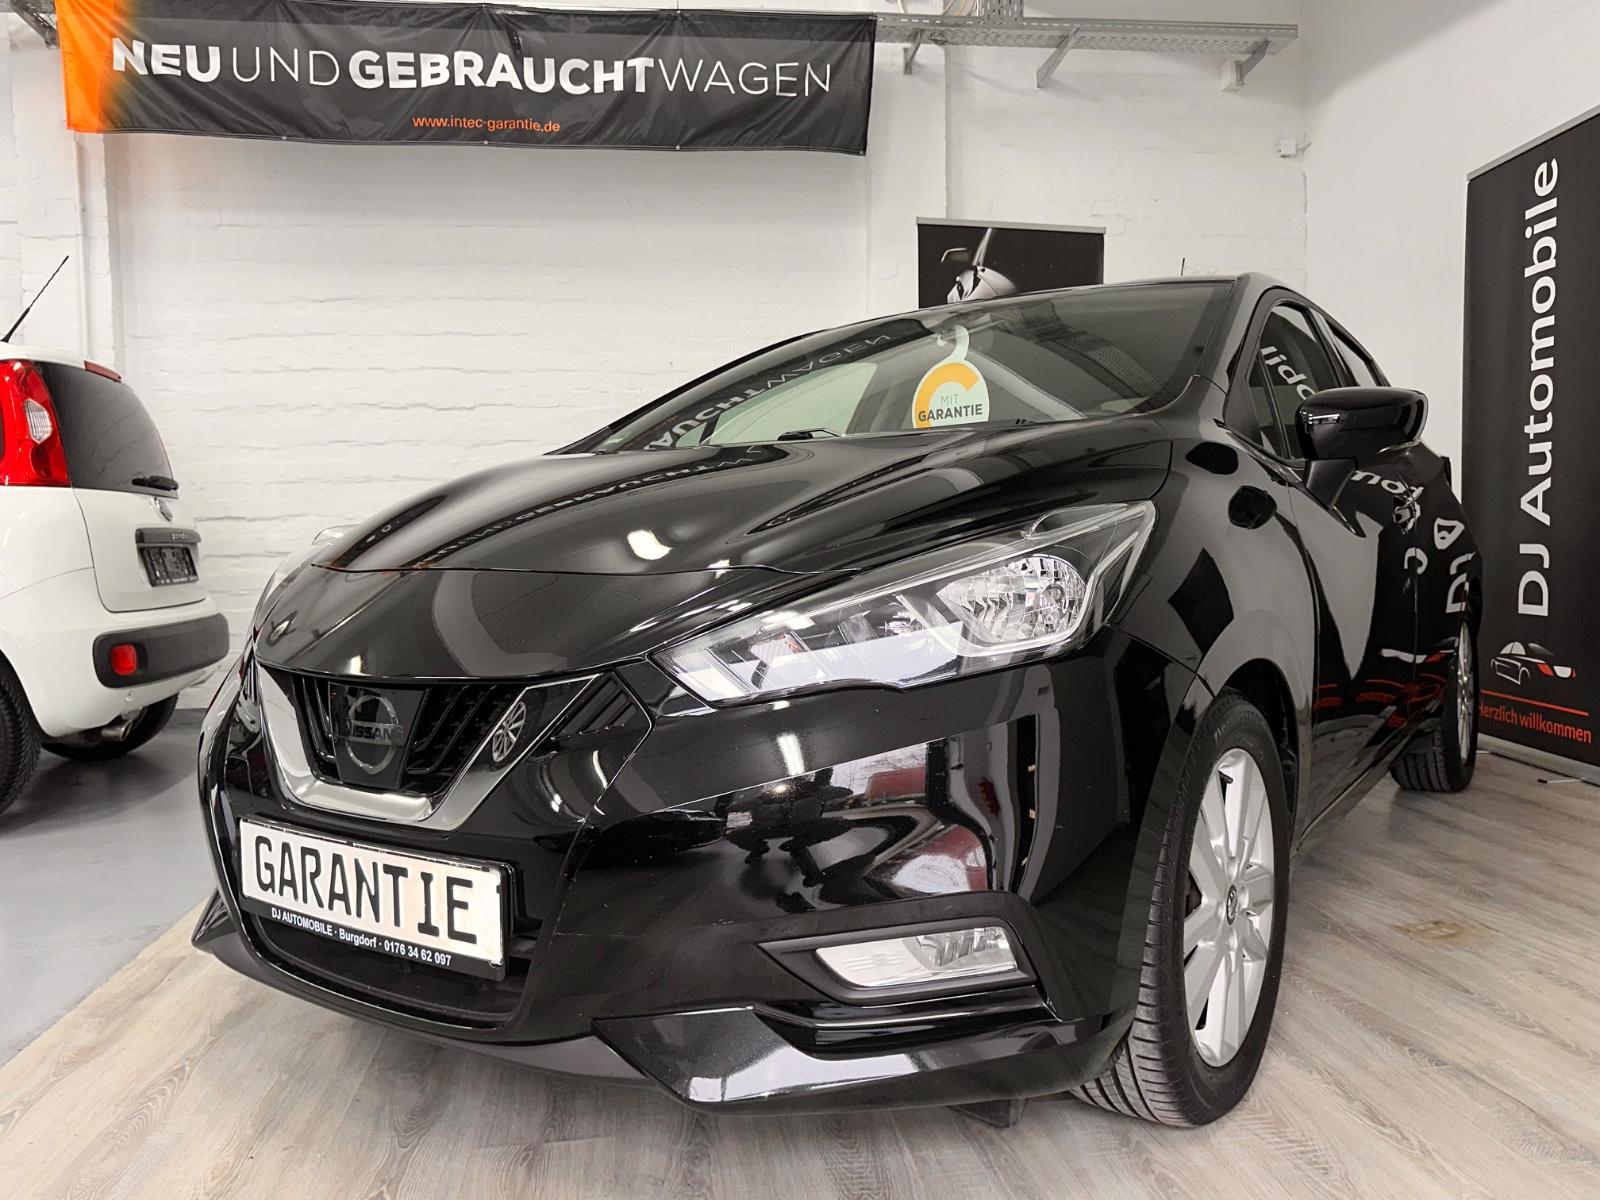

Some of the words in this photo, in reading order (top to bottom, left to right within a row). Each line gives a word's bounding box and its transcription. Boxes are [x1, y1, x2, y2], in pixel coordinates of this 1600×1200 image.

[412, 115, 561, 133] www.intec-garantie.de
[1520, 157, 1560, 526] Automobile
[918, 403, 983, 422] GARANTIE
[940, 393, 959, 405] MIT
[1517, 543, 1549, 616] DJ
[1519, 712, 1592, 744] willkommen
[255, 835, 478, 944] GARANTIE
[271, 907, 282, 920] DJ
[282, 911, 333, 937] AUTOMOBILE
[339, 928, 378, 948] Burgdorf
[384, 941, 406, 956] 0176
[407, 946, 419, 959] 34
[421, 949, 433, 962] 62
[434, 951, 452, 967] 097
